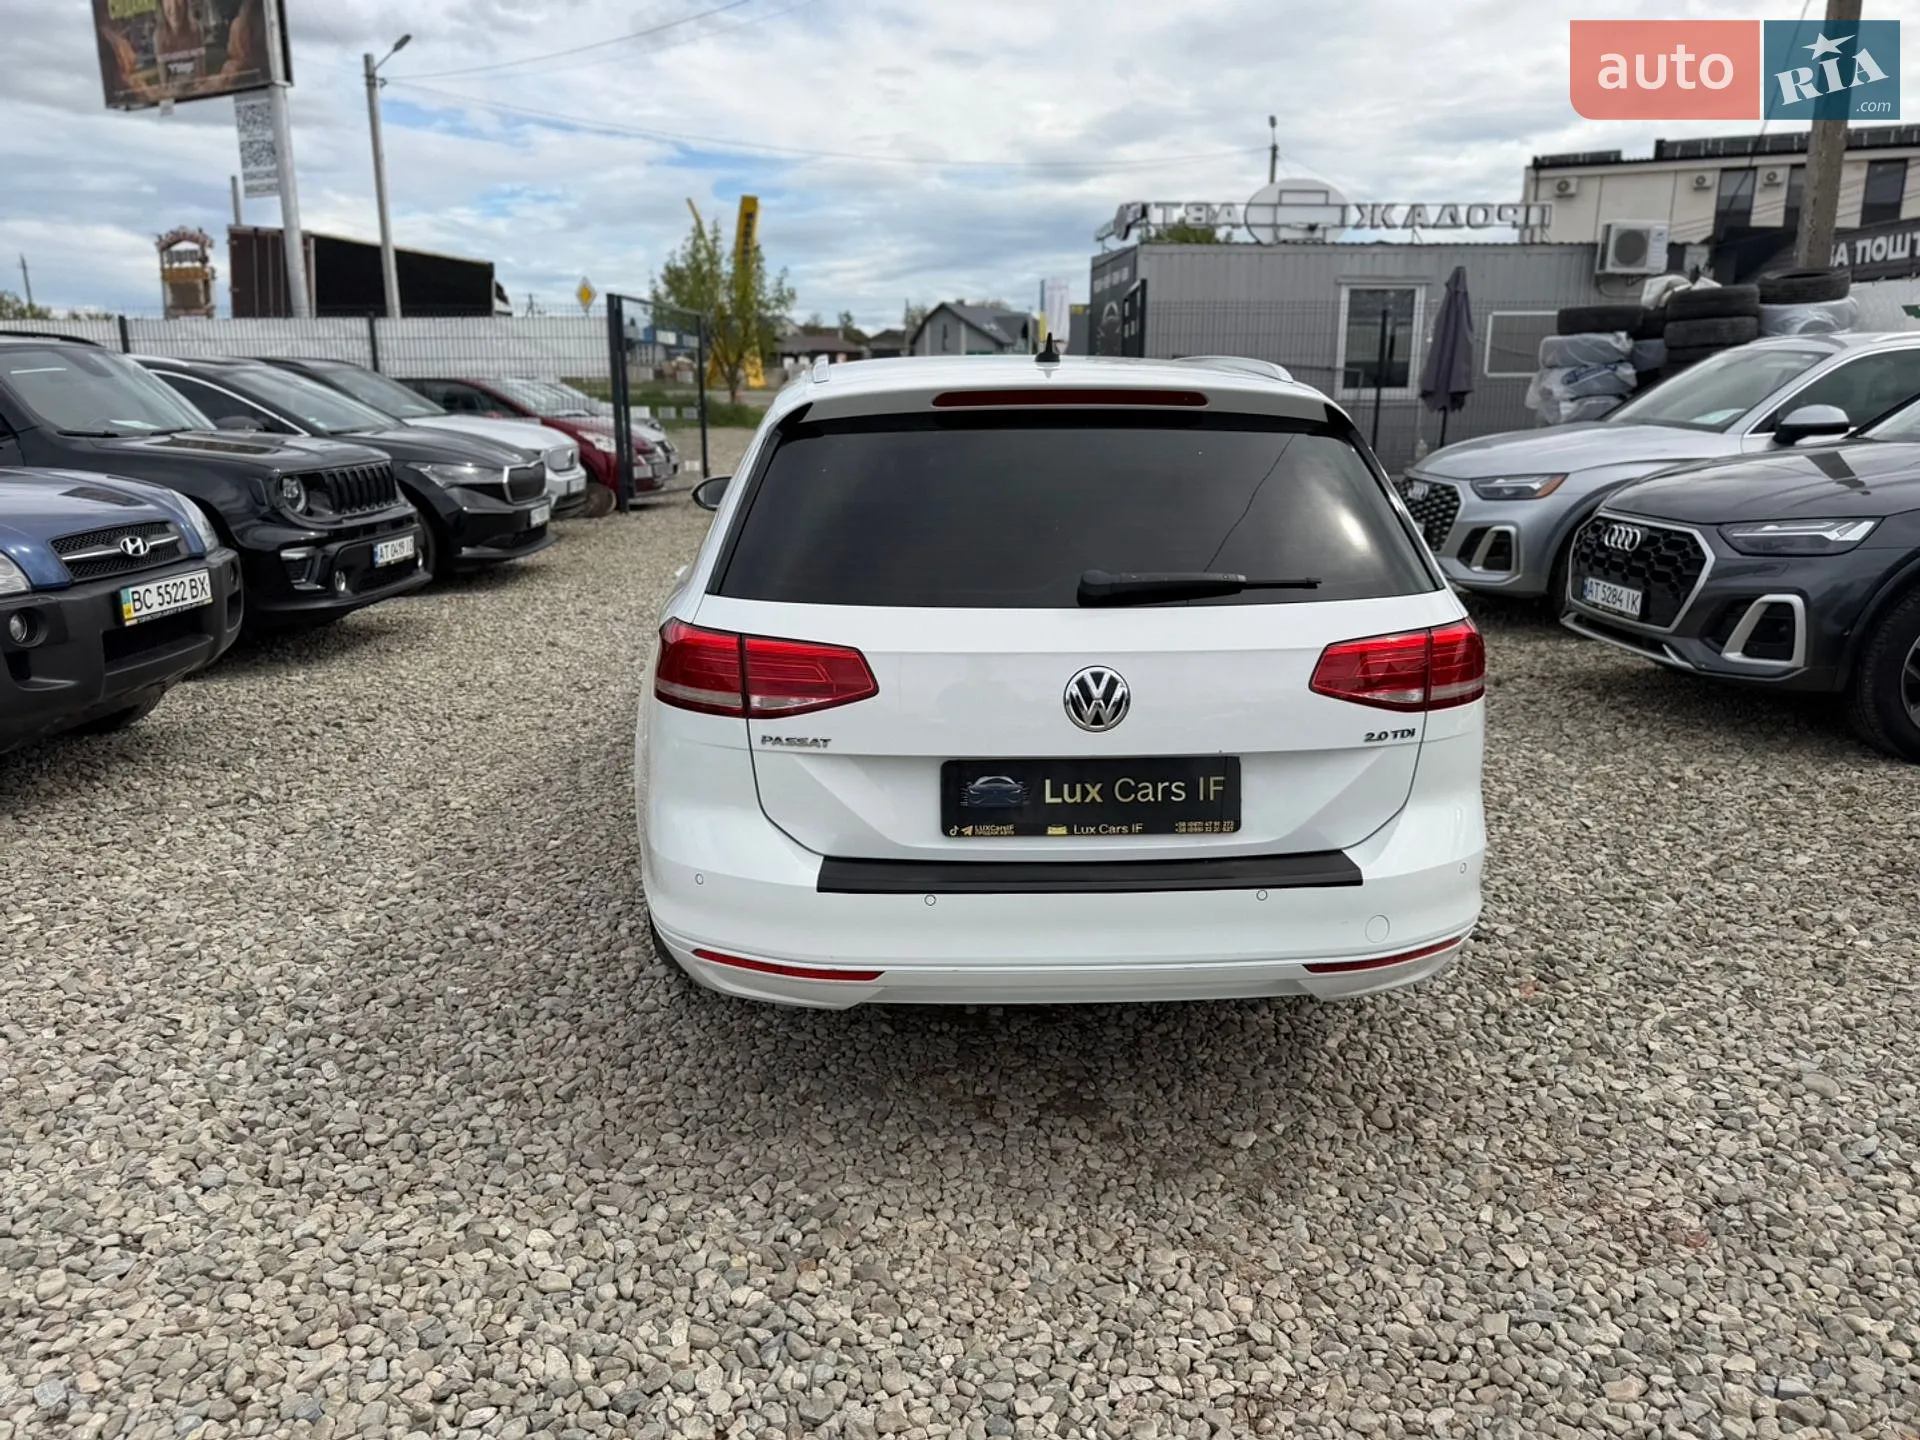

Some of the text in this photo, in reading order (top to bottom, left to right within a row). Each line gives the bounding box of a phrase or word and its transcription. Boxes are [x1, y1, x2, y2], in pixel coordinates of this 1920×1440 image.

[131, 590, 153, 612] BC
[157, 581, 188, 606] 5522
[190, 576, 208, 600] BX
[1587, 580, 1600, 600] AT
[761, 735, 832, 748] PASSAT
[1363, 728, 1416, 743] 2.0 TDI
[1045, 776, 1225, 803] Lux Cars IF
[1073, 823, 1144, 835] Lux Cars IF
